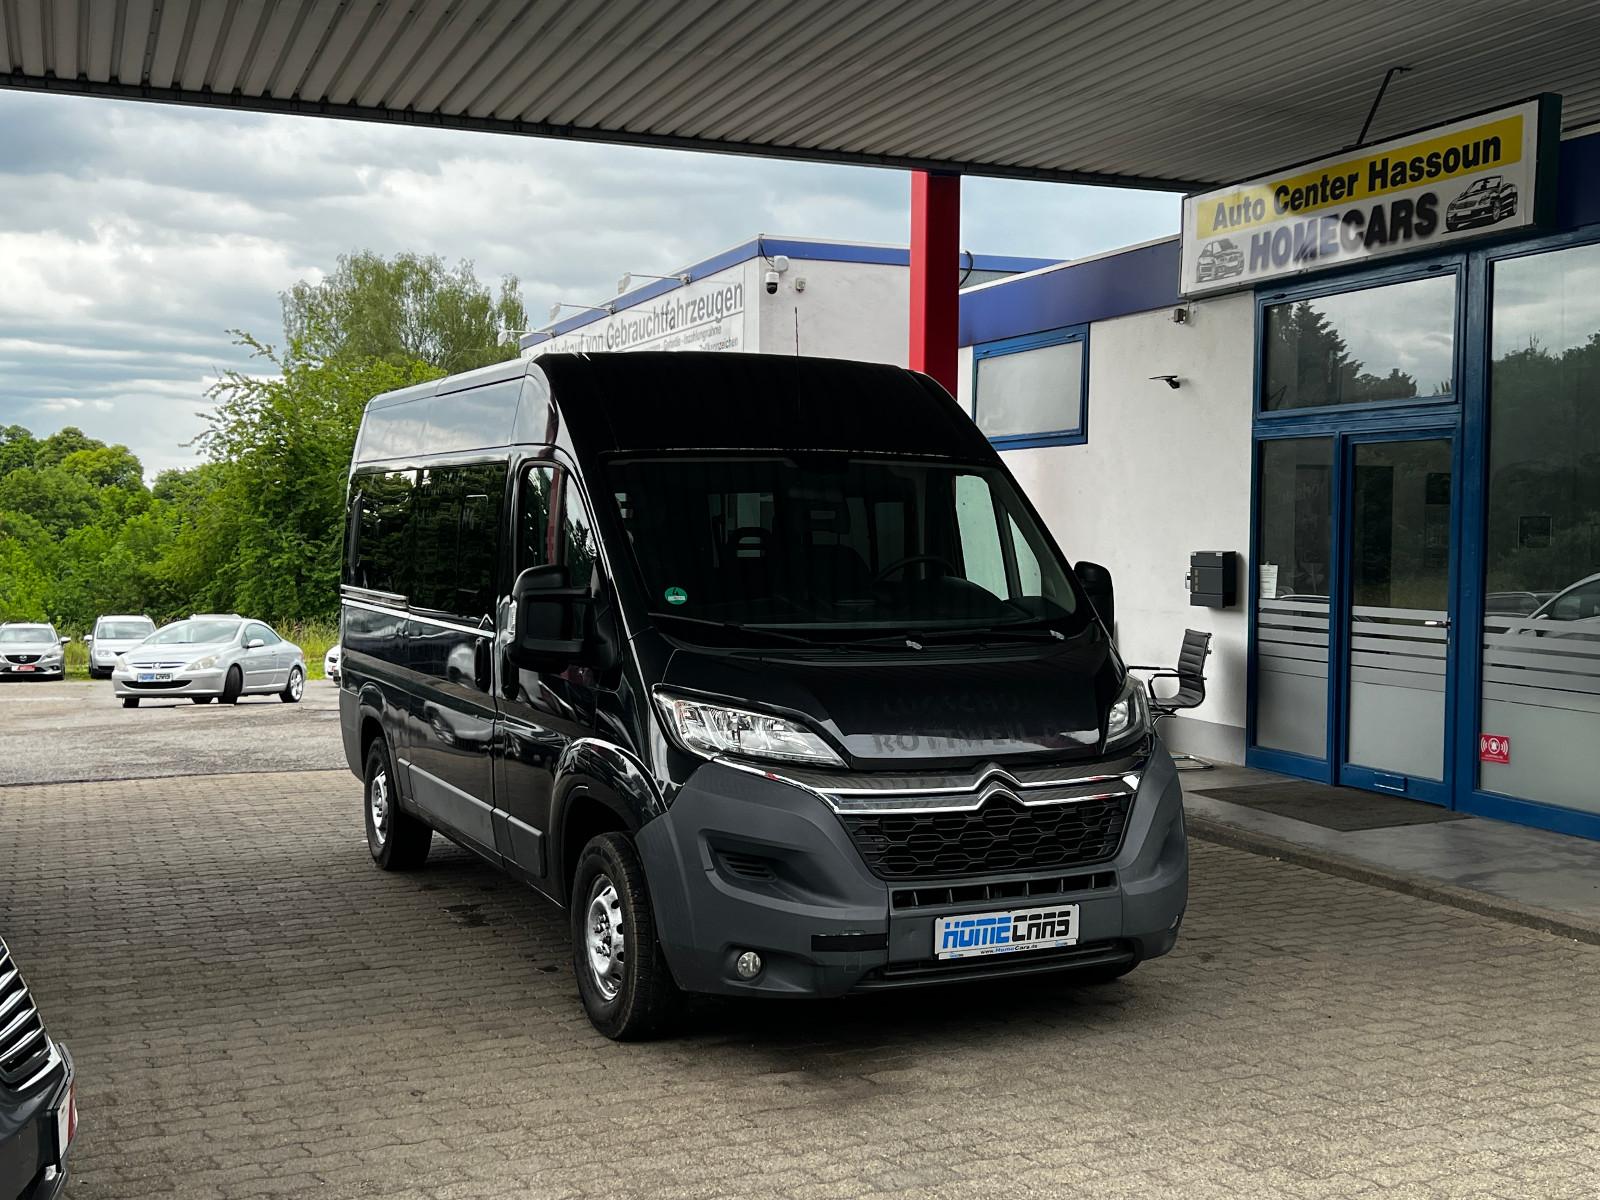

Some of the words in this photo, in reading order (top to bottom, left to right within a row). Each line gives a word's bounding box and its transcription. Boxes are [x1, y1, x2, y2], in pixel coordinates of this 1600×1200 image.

[1212, 196, 1266, 232] Auto
[1273, 171, 1360, 215] Center
[1367, 135, 1502, 192] Hassoun
[1250, 192, 1440, 272] HOMECARS
[586, 334, 604, 352] von
[606, 282, 743, 350] Gebrauchtfahrzeugen
[942, 910, 1071, 949] HOMECARS
